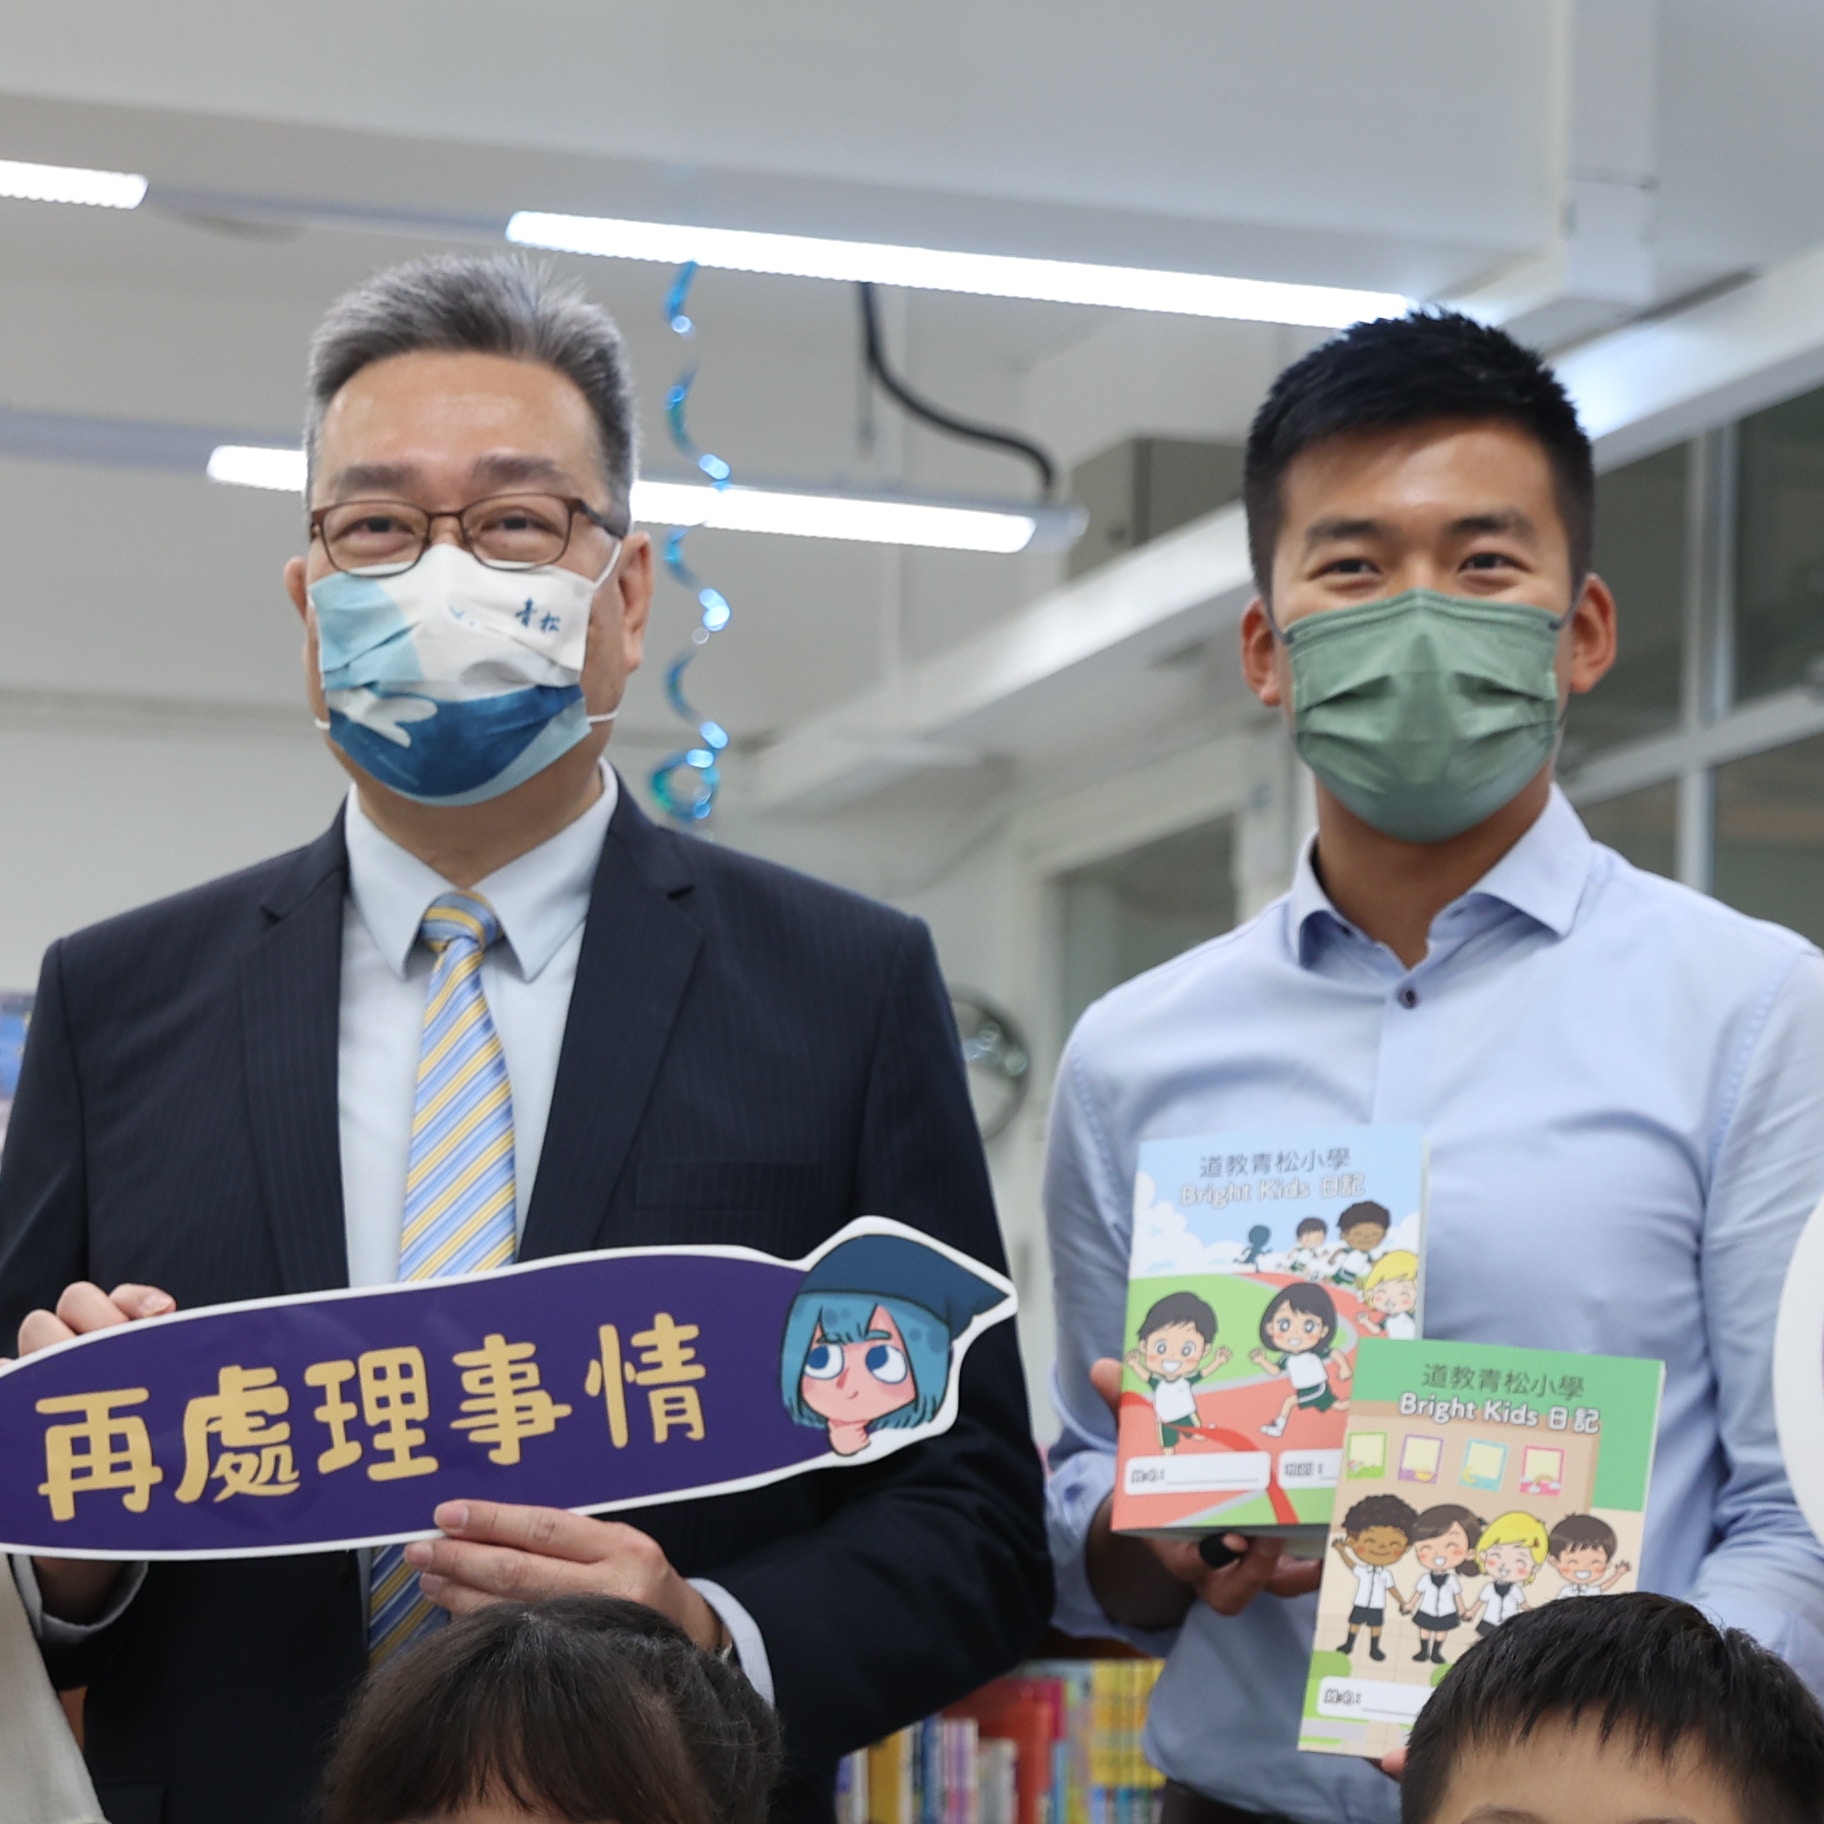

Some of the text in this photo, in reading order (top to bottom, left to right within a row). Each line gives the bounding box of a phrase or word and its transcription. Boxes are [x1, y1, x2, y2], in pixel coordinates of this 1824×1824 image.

[1199, 1147, 1351, 1178] 道教青松小學
[1180, 1173, 1366, 1209] Bright Kids 日記
[1421, 1362, 1585, 1400] 道教青松小學
[35, 1311, 707, 1522] 再處理事情
[1398, 1392, 1601, 1434] Bright Kids 日記
